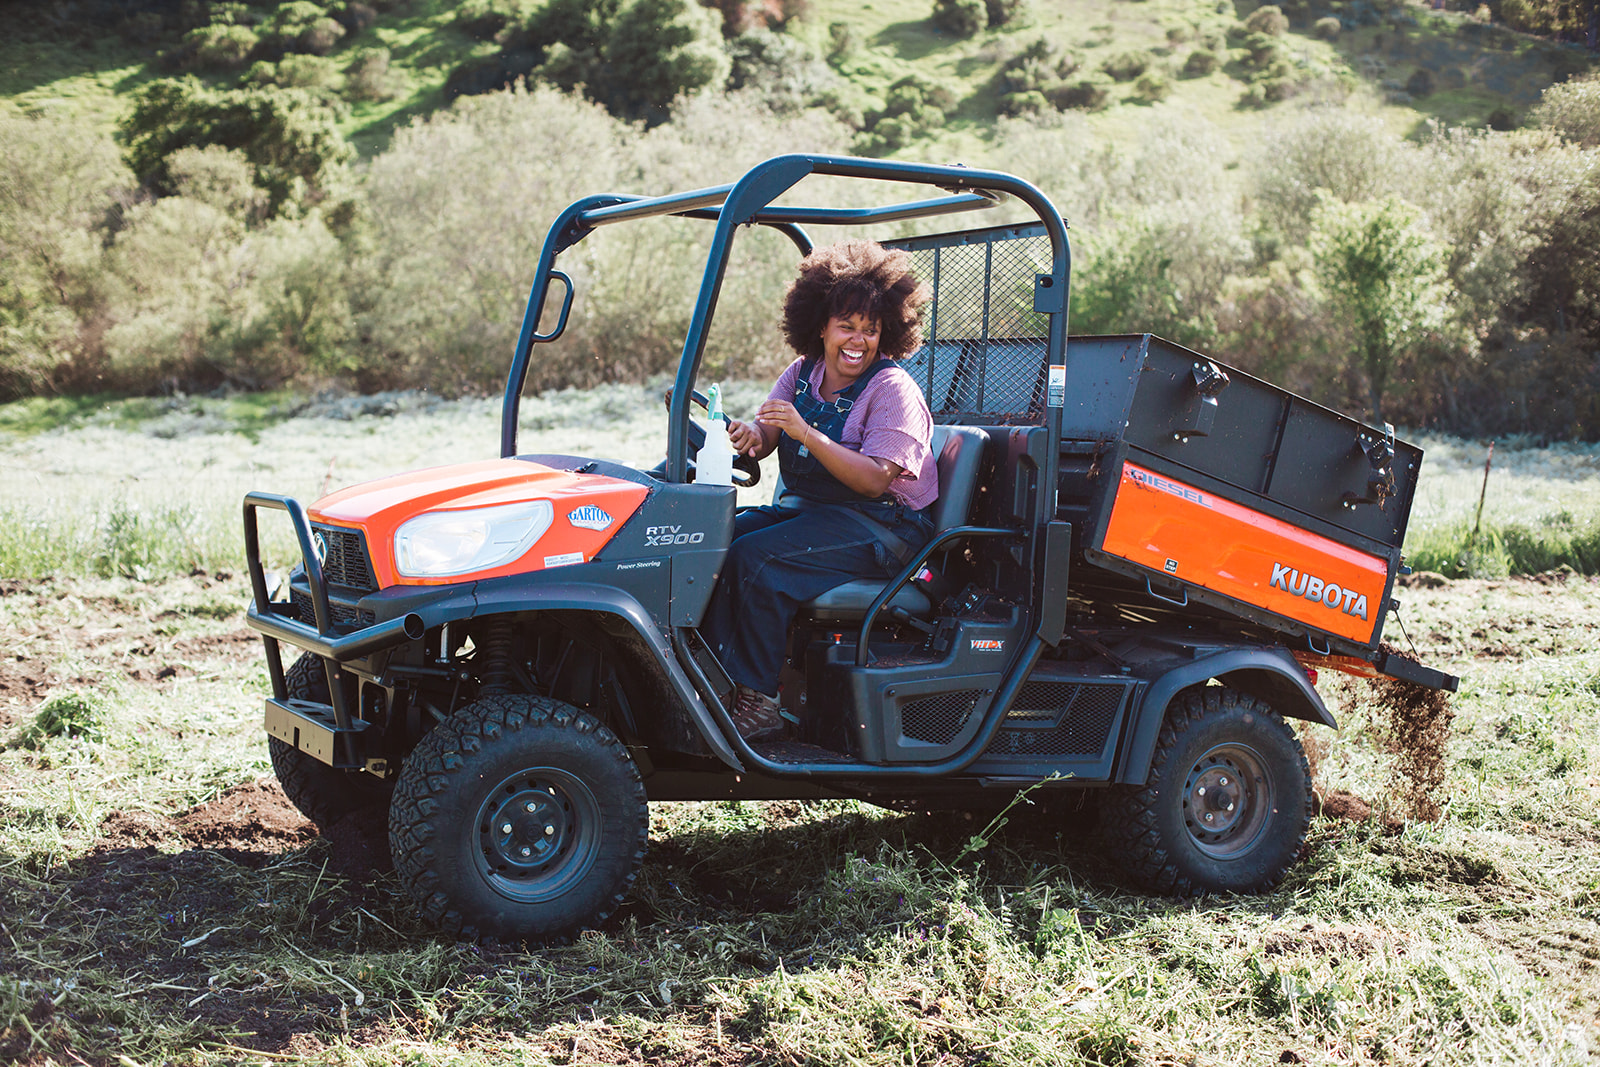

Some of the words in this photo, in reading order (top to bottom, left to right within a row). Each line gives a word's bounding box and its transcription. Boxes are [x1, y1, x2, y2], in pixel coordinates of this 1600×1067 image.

[1130, 468, 1212, 508] DIESEL
[568, 507, 612, 522] GARTON
[645, 525, 682, 535] RTV
[643, 532, 705, 547] X900
[616, 562, 636, 570] Power
[636, 560, 661, 568] Steering
[1269, 562, 1368, 622] KUBOTA
